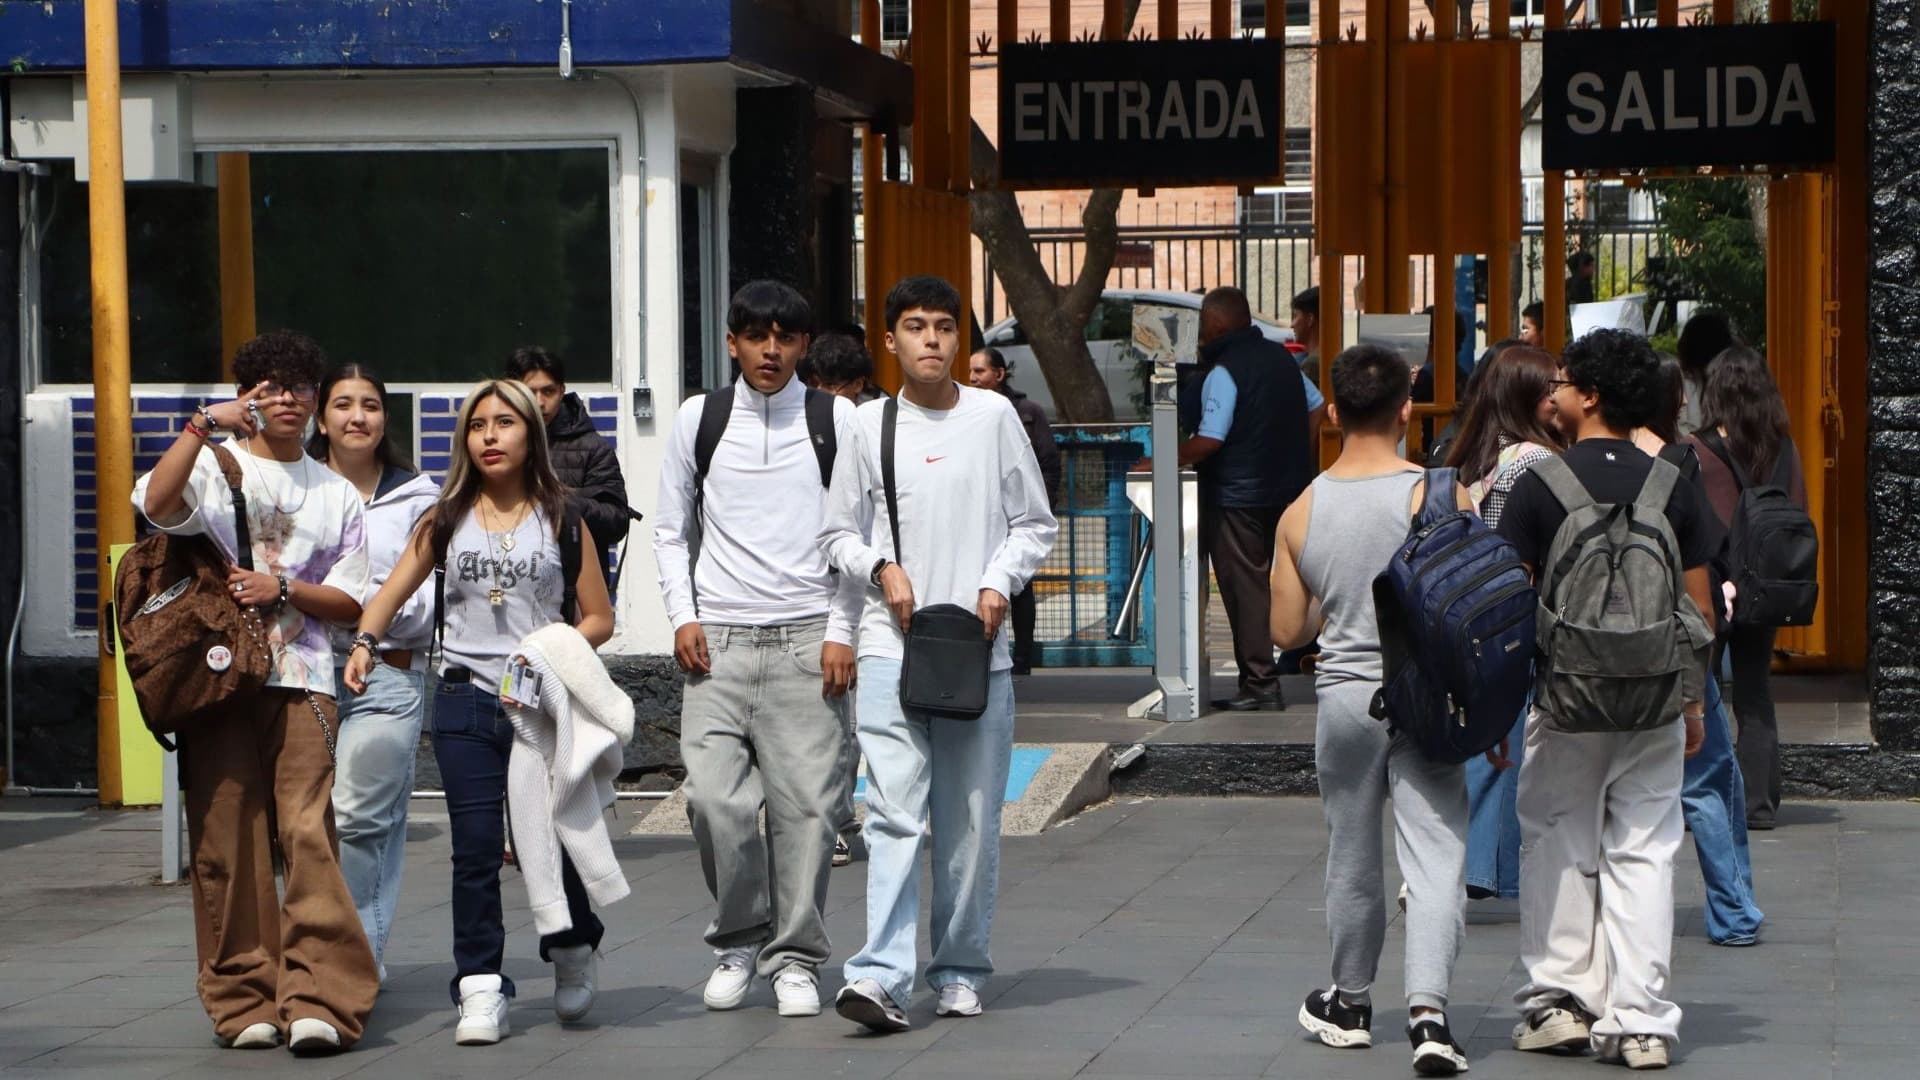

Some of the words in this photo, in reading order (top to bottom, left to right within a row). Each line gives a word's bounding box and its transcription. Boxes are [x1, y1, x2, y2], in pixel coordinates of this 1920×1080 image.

[1015, 79, 1264, 141] ENTRADA
[1566, 63, 1816, 135] SALIDA
[457, 550, 545, 589] Angel
